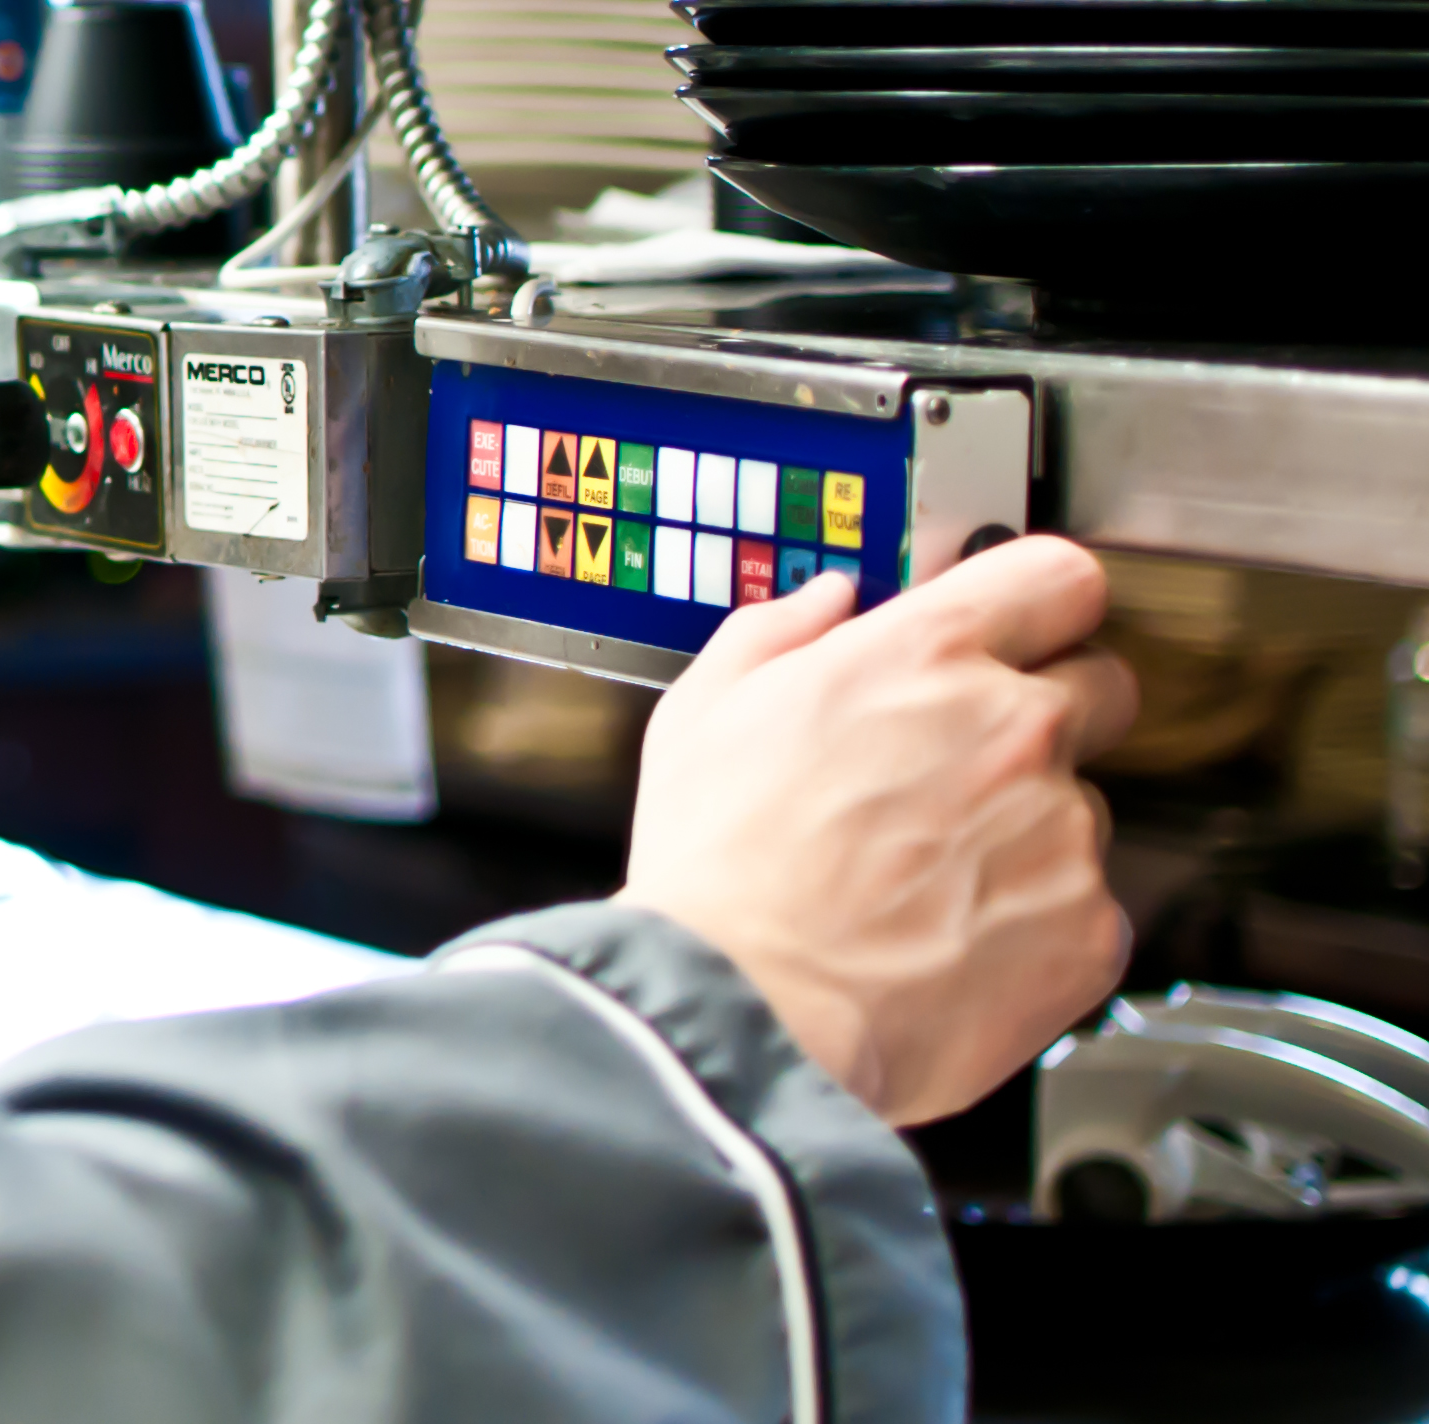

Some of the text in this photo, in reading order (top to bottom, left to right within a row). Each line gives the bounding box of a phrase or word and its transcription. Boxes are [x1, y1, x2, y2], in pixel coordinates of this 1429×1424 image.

[102, 342, 154, 375] Merco
[187, 361, 266, 386] MERCO
[474, 430, 500, 451] EXE-
[471, 456, 501, 479] CUTÉ
[584, 488, 609, 506] PAGE
[826, 509, 862, 533] TOUR
[470, 537, 496, 559] TION
[623, 550, 643, 570] FIN
